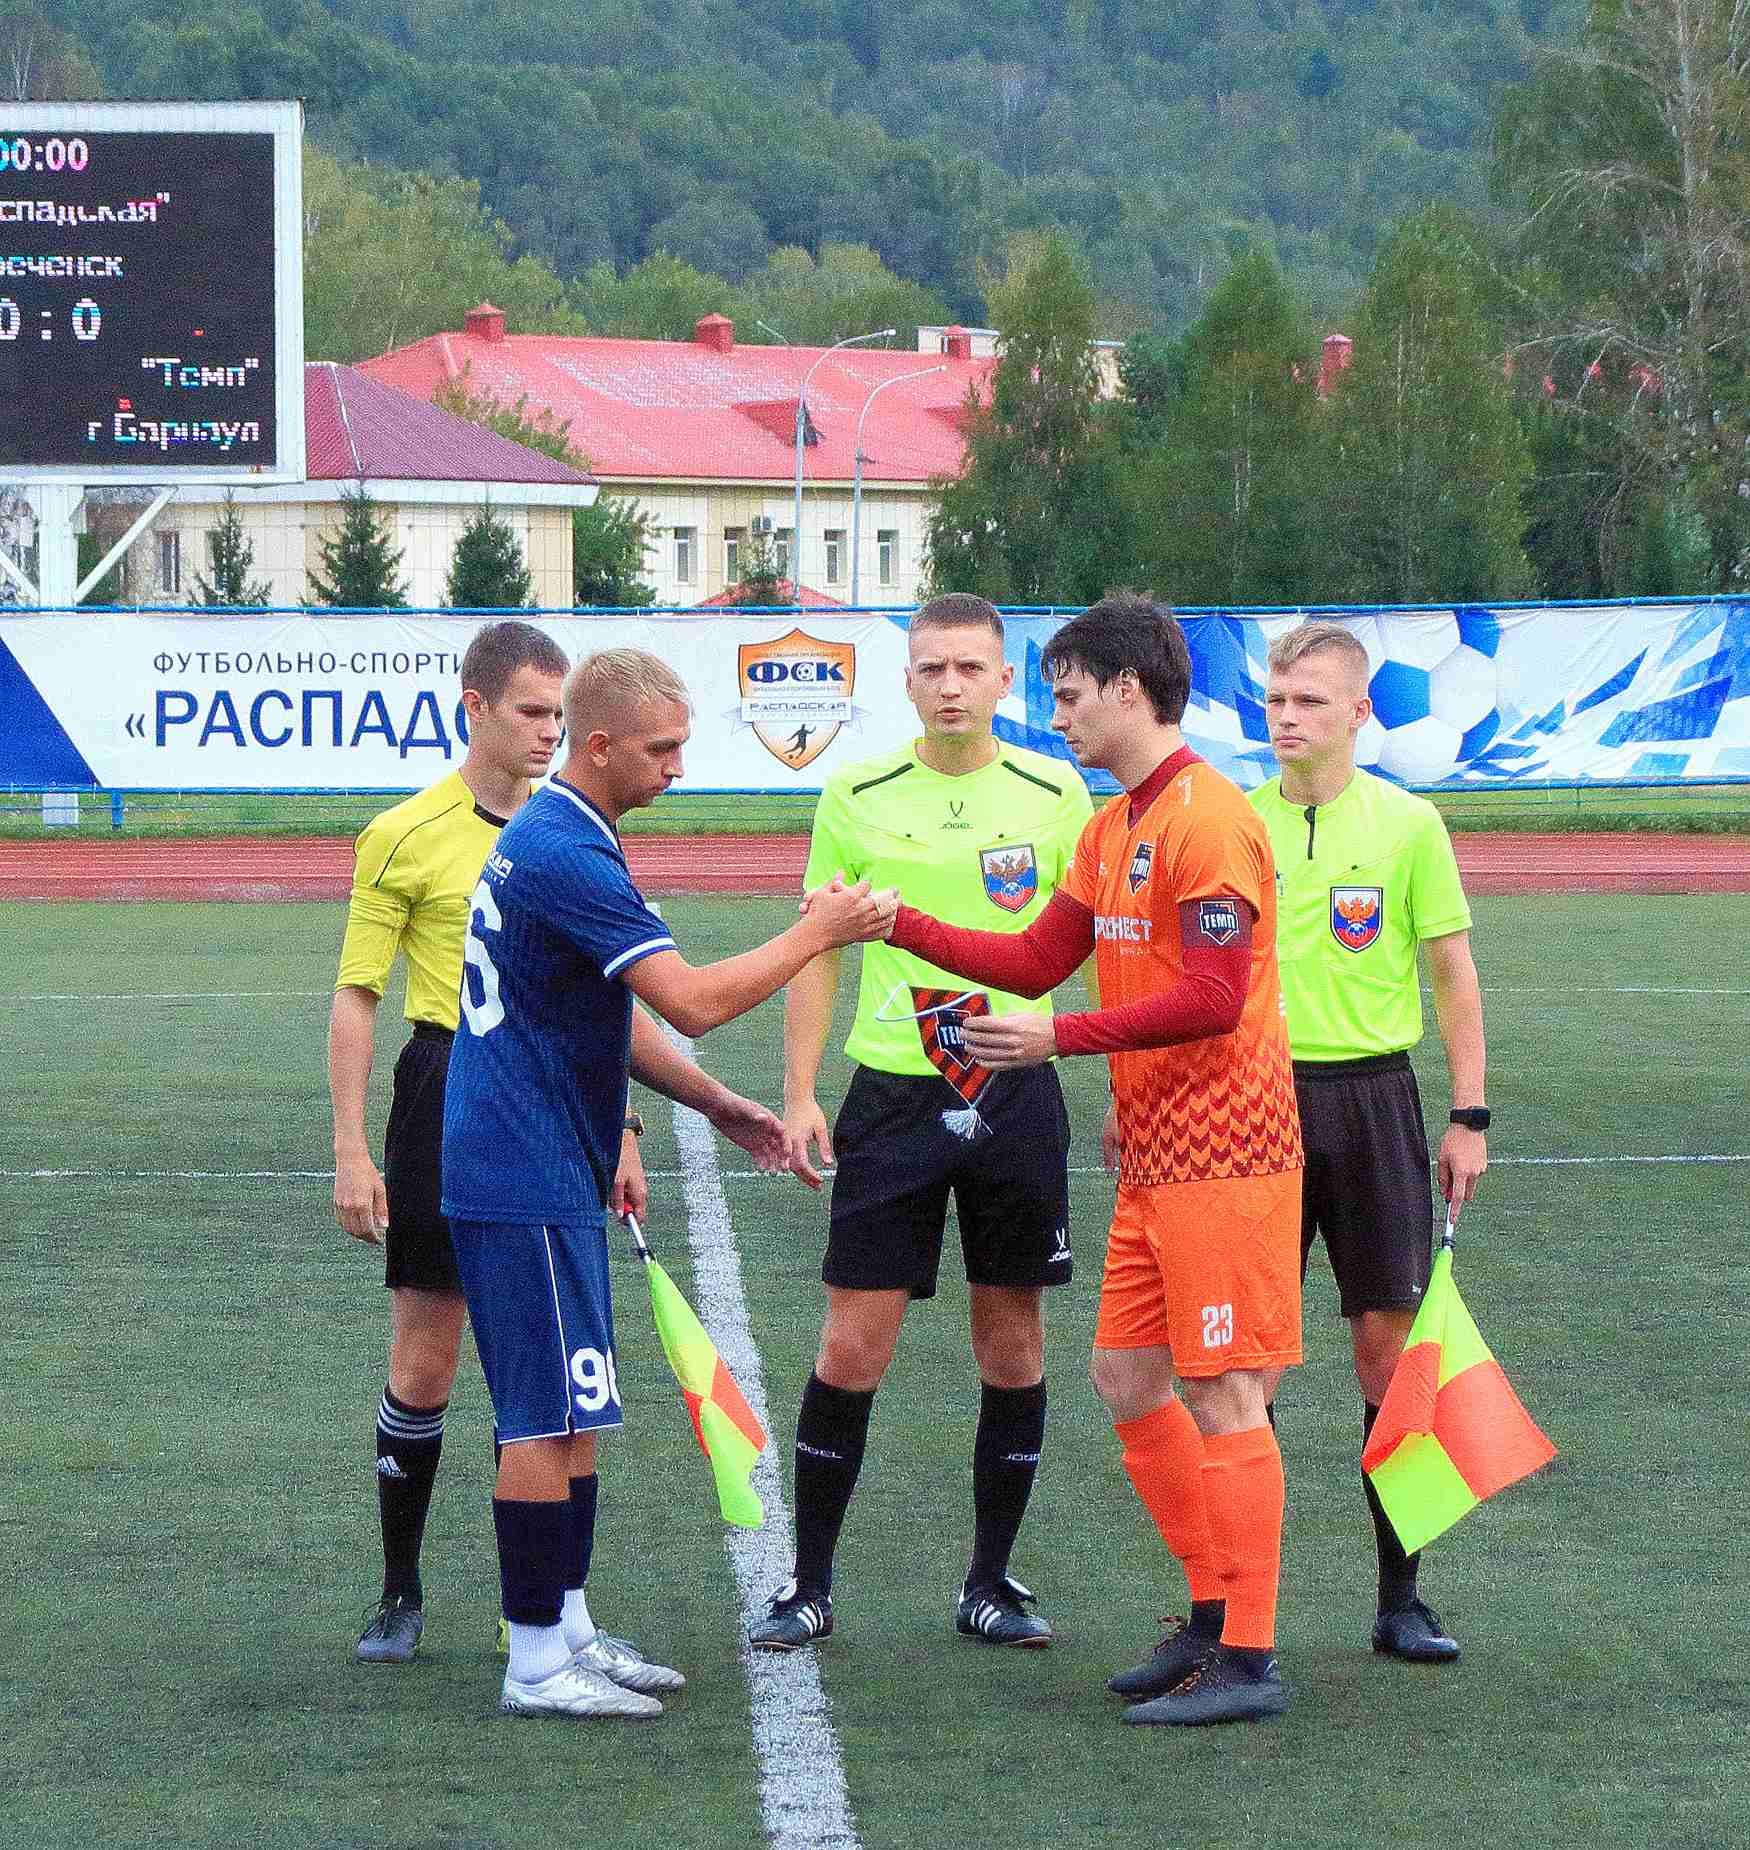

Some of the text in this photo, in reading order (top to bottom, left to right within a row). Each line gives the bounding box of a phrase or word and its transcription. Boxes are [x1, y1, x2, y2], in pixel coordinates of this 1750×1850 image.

[0, 256, 124, 278] еченск
[124, 689, 469, 759] «РАСПАД
[1203, 913, 1236, 929] ТЕМП
[1201, 1303, 1232, 1348] 23
